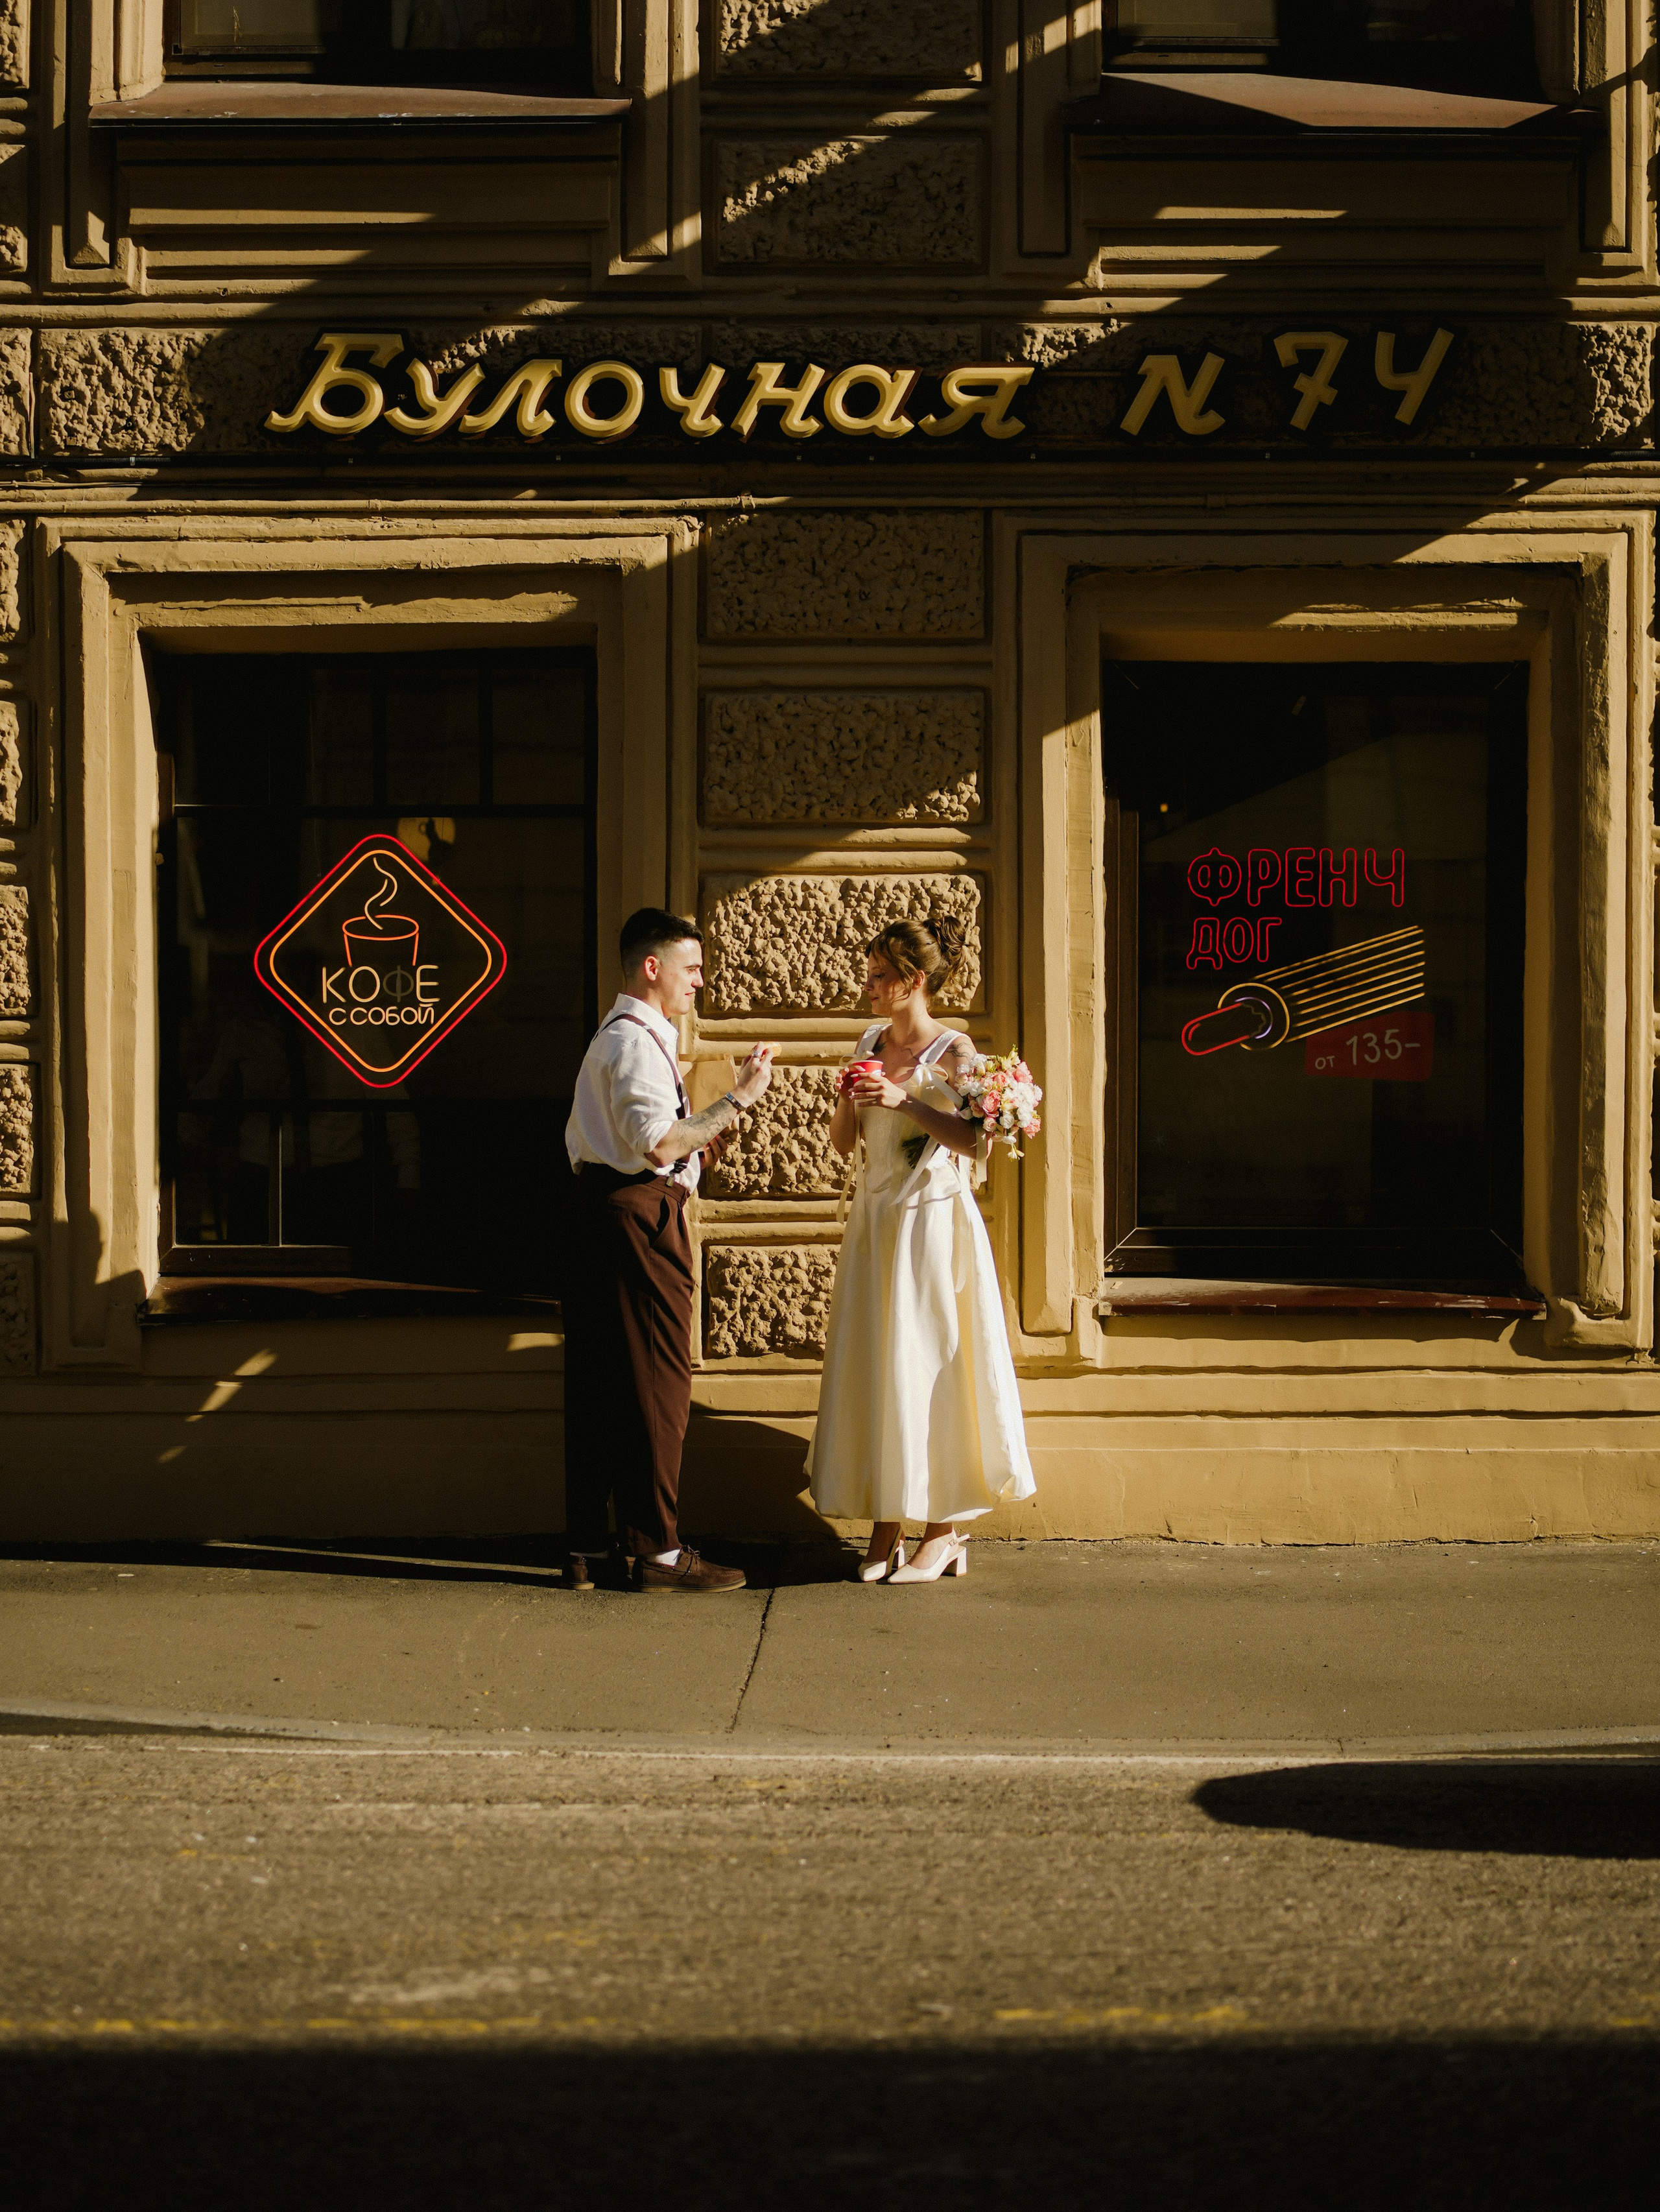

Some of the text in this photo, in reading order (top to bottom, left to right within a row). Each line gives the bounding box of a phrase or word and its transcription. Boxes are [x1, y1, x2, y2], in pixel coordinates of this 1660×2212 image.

[263, 331, 1036, 440] Булочная
[1187, 847, 1405, 907] ФРЕНЧ
[1186, 917, 1283, 970] ДОГ
[322, 964, 441, 1004] КОФЕ
